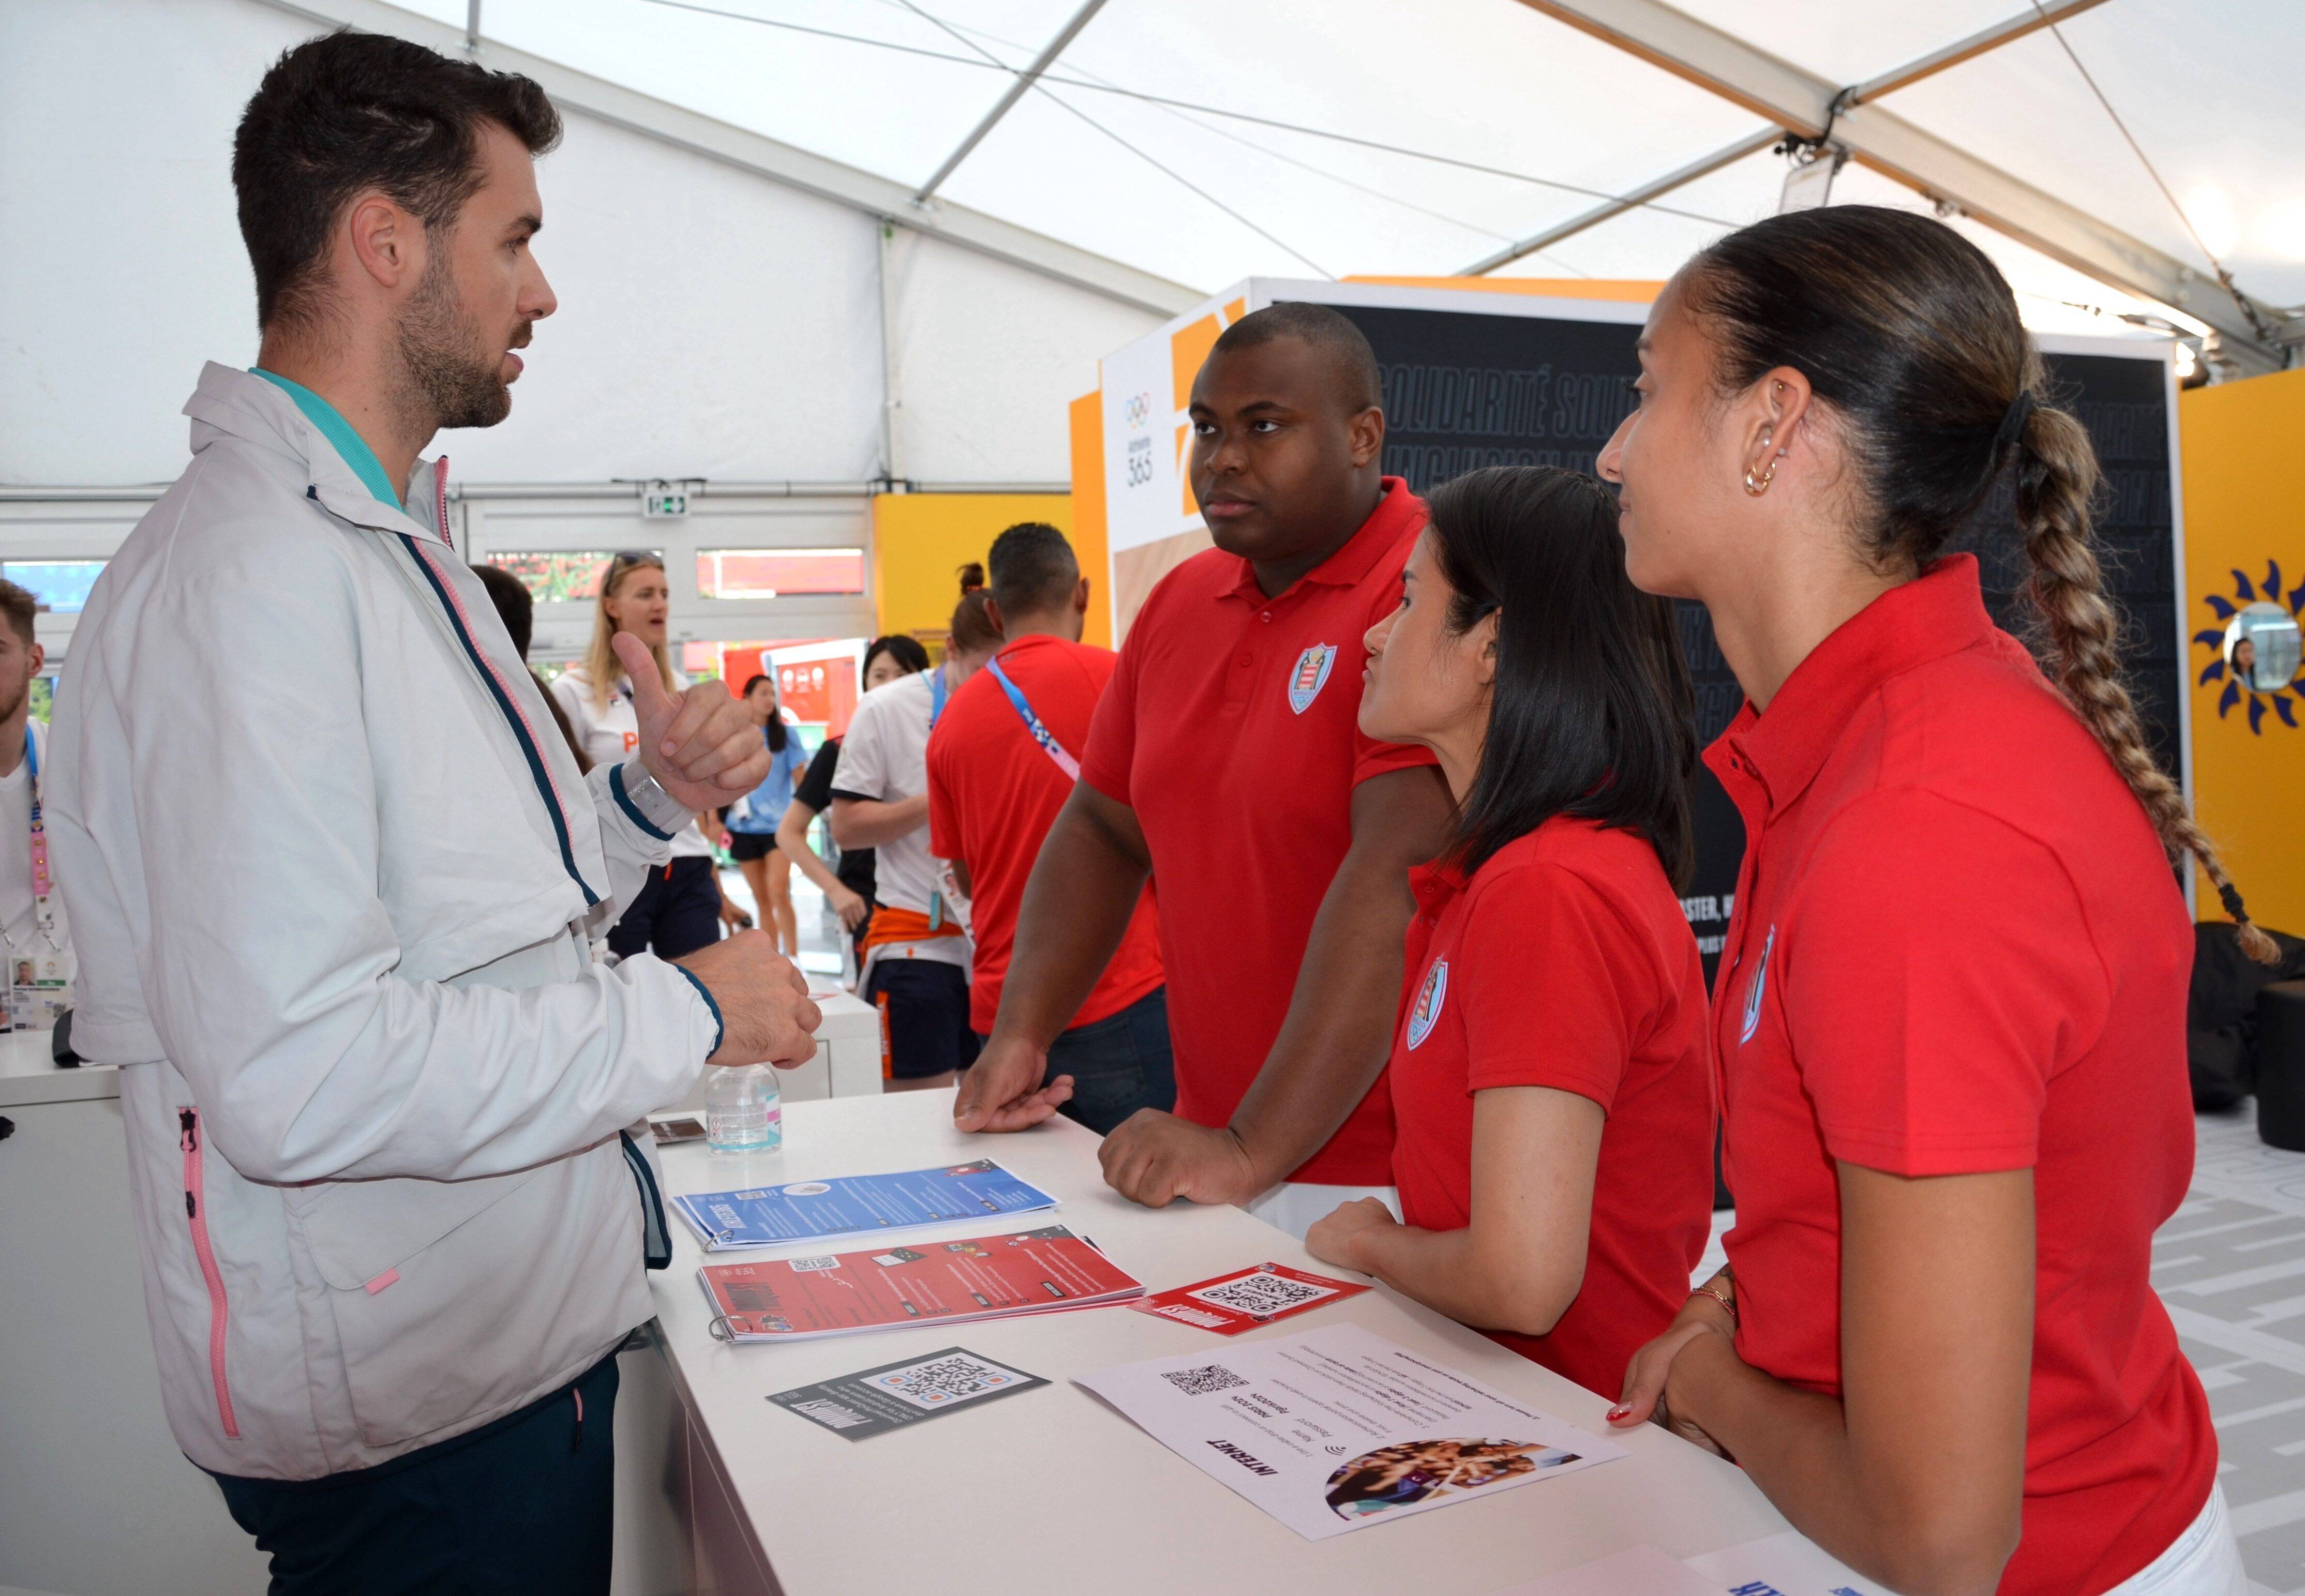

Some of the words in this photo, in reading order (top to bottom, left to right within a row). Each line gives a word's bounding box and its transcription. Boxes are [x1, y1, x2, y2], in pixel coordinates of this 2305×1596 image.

[1232, 1396, 1253, 1406] 2024
[789, 1398, 873, 1428] PINQUEST
[1248, 1407, 1272, 1418] PARIS
[1294, 1419, 1333, 1437] Password
[1292, 1430, 1315, 1442] Name
[1206, 1440, 1278, 1475] INTERNET
